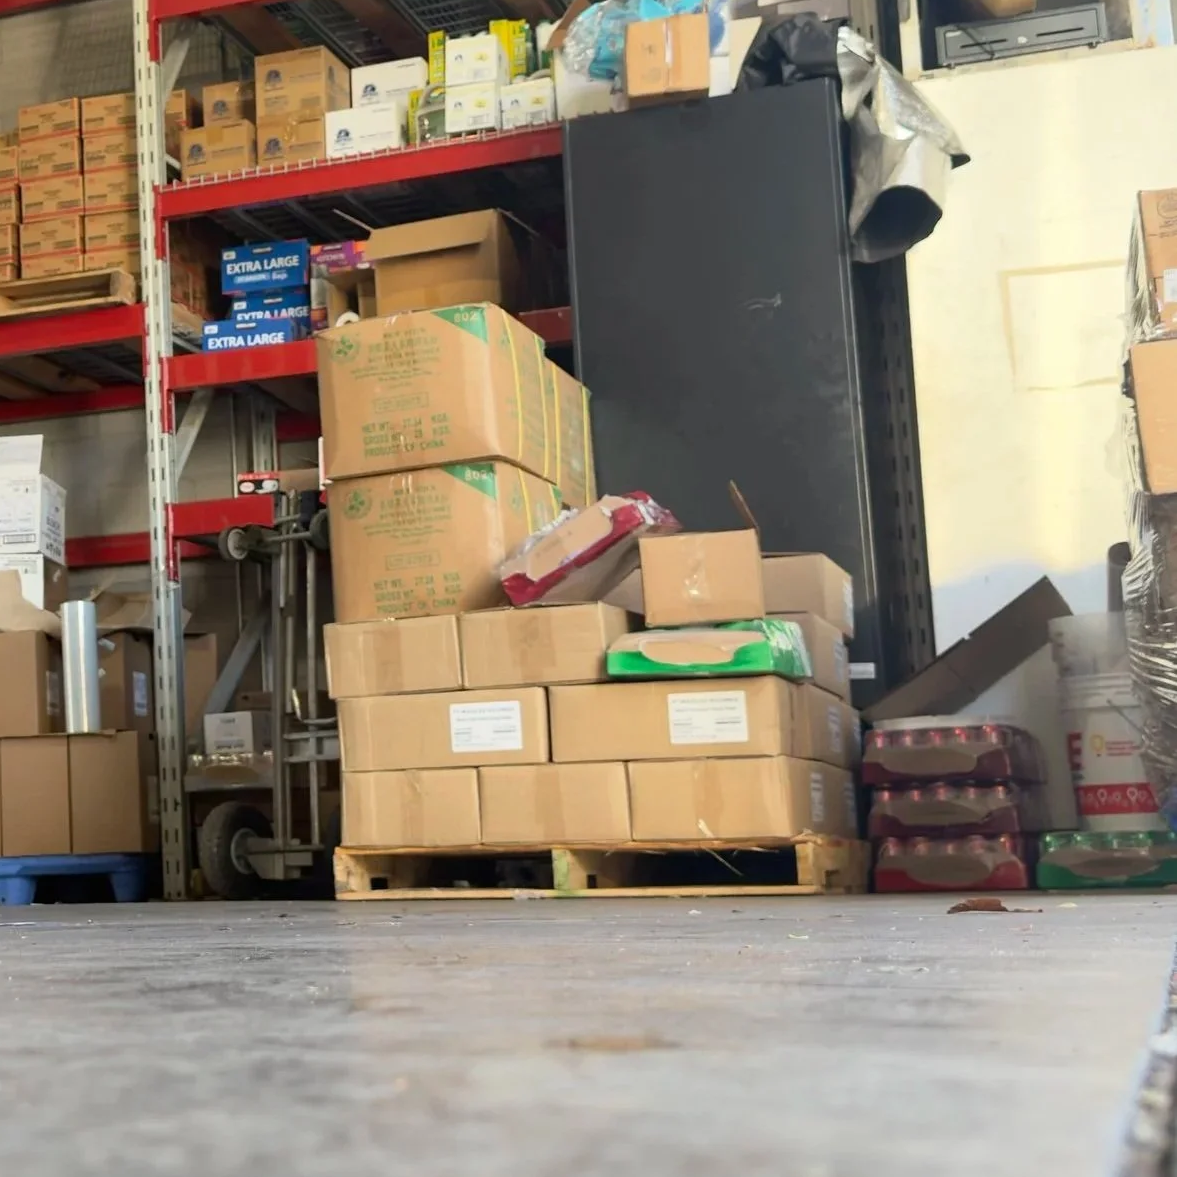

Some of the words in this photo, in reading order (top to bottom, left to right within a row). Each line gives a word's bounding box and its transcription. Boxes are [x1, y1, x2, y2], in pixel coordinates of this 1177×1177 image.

[226, 259, 263, 275] EXTRA
[263, 255, 300, 270] LARGE
[208, 335, 246, 349] EXTRA
[247, 332, 286, 346] LARGE
